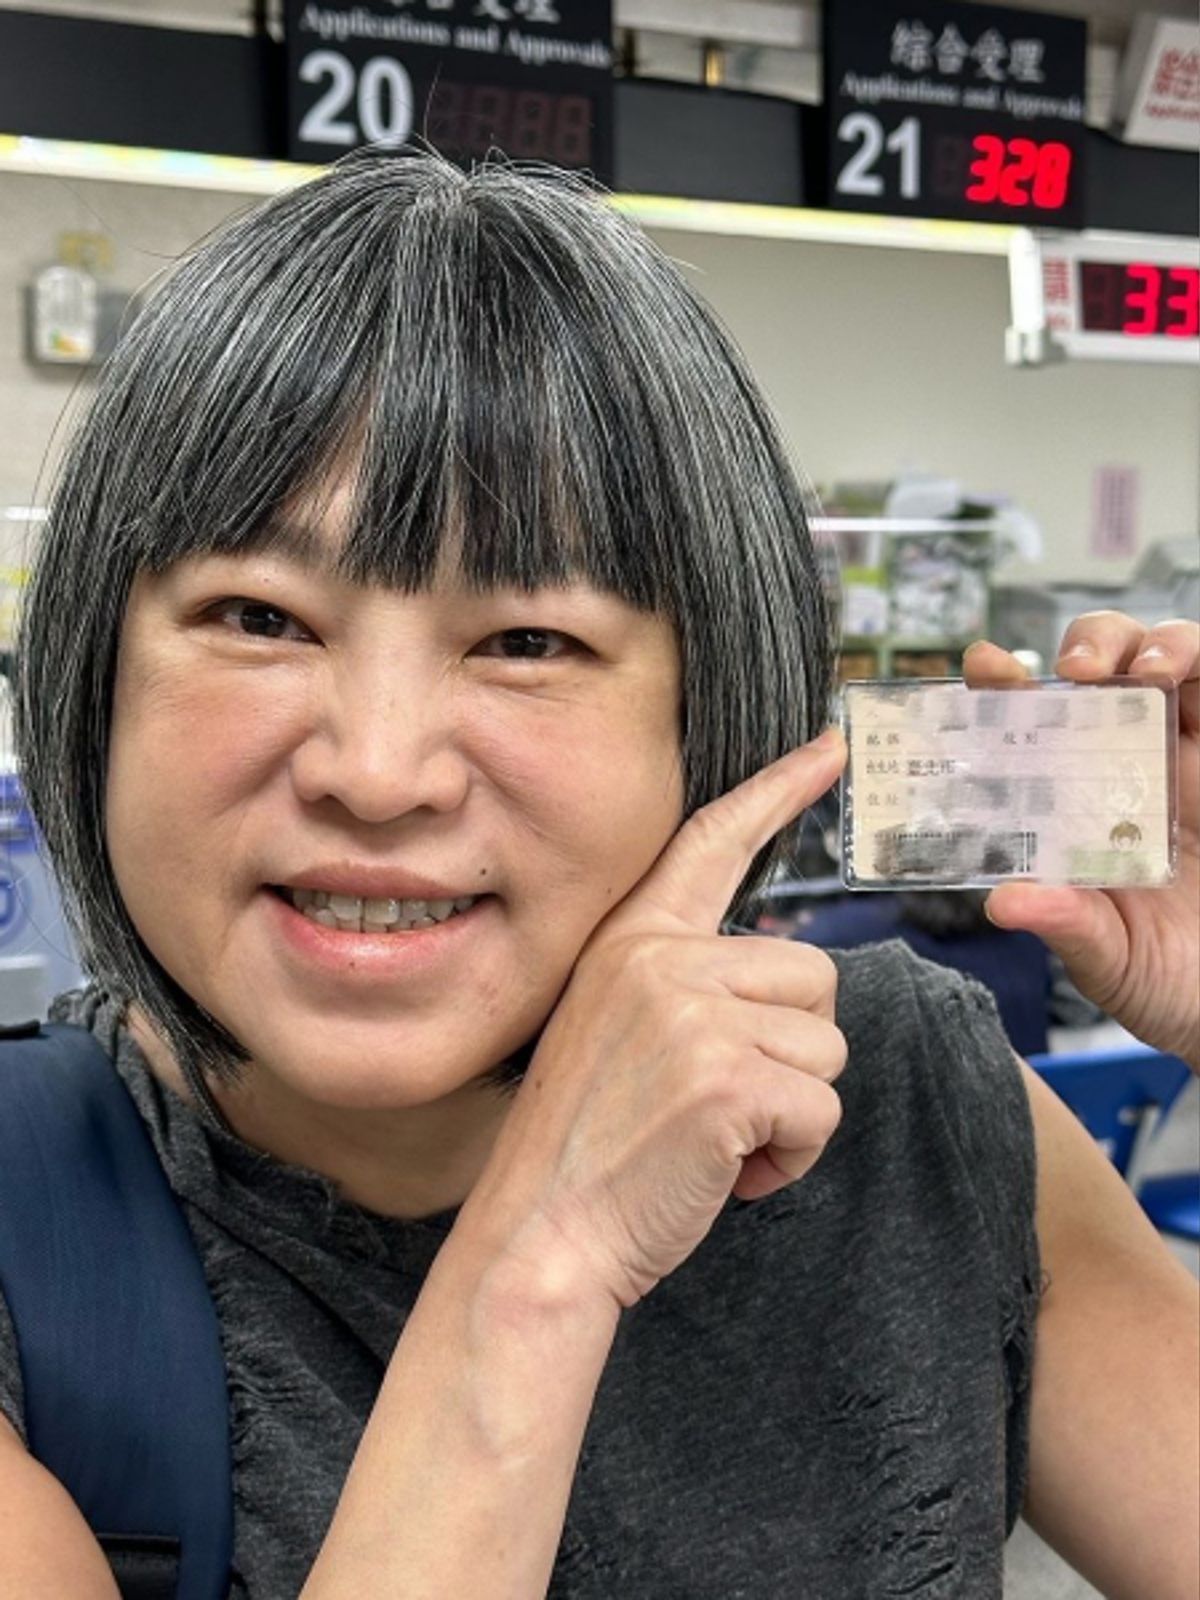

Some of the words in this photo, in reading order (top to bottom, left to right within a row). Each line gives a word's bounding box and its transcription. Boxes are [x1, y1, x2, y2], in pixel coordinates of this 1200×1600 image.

[301, 5, 450, 45] Applications
[454, 25, 500, 51] and
[299, 50, 414, 149] 20
[836, 112, 919, 198] 21
